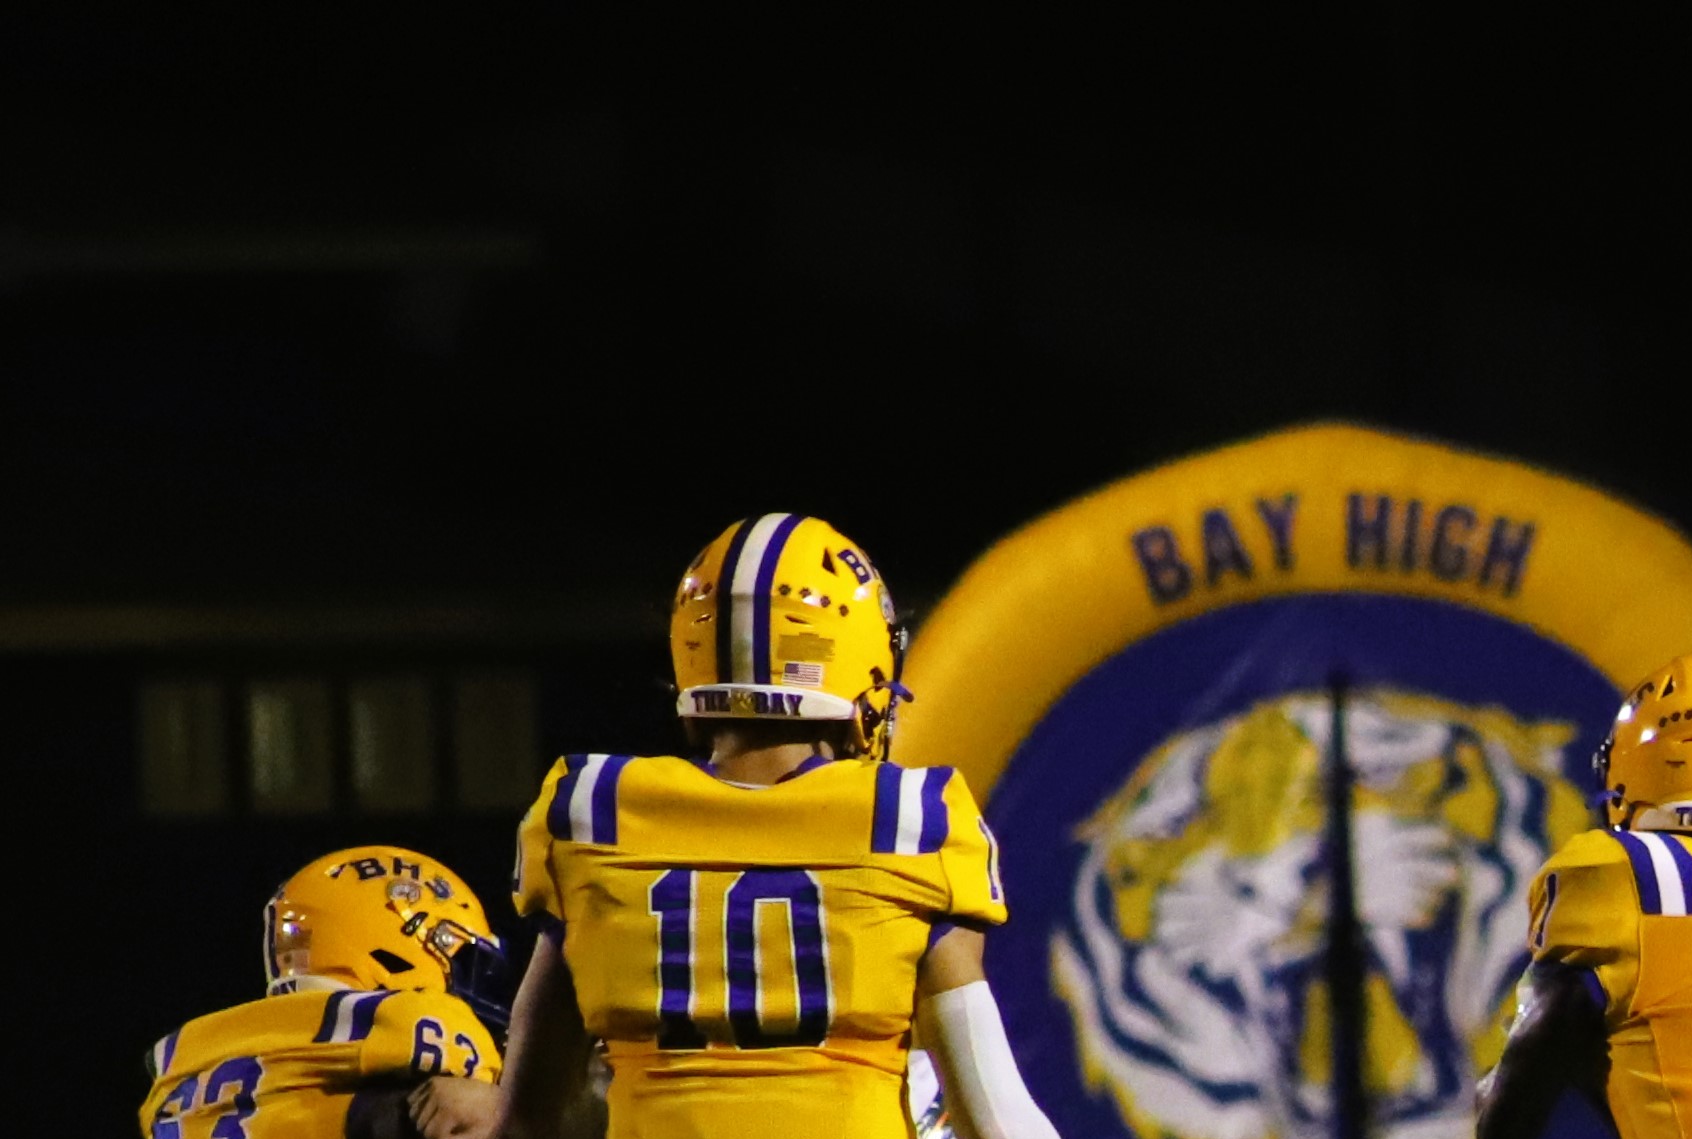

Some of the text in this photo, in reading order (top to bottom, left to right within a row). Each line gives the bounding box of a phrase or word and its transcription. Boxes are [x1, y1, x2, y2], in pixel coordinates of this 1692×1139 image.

[1130, 492, 1537, 606] BAY HIGH
[647, 868, 835, 1051] 10
[410, 1016, 482, 1079] 63
